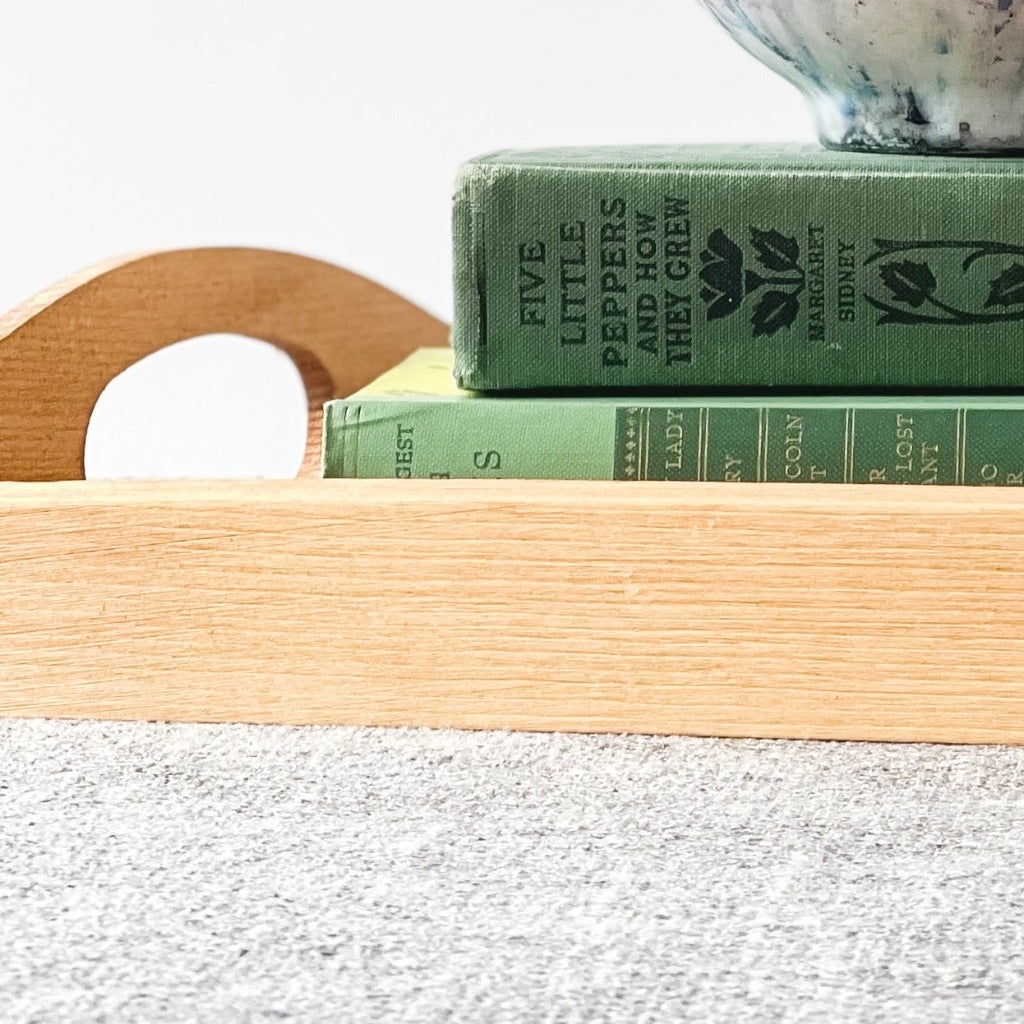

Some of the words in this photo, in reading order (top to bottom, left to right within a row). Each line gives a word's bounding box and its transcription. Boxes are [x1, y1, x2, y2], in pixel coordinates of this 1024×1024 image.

[635, 212, 657, 283] HOW
[664, 196, 690, 281] GREW
[519, 240, 547, 328] FIVE
[560, 220, 588, 348] LITTLE
[601, 197, 628, 368] PEPPERS
[808, 223, 826, 342] MARGARET
[838, 239, 855, 323] SIDNEY
[636, 293, 658, 355] AND
[665, 289, 692, 367] THEY
[665, 409, 684, 470] LADY
[896, 413, 914, 472] LOST
